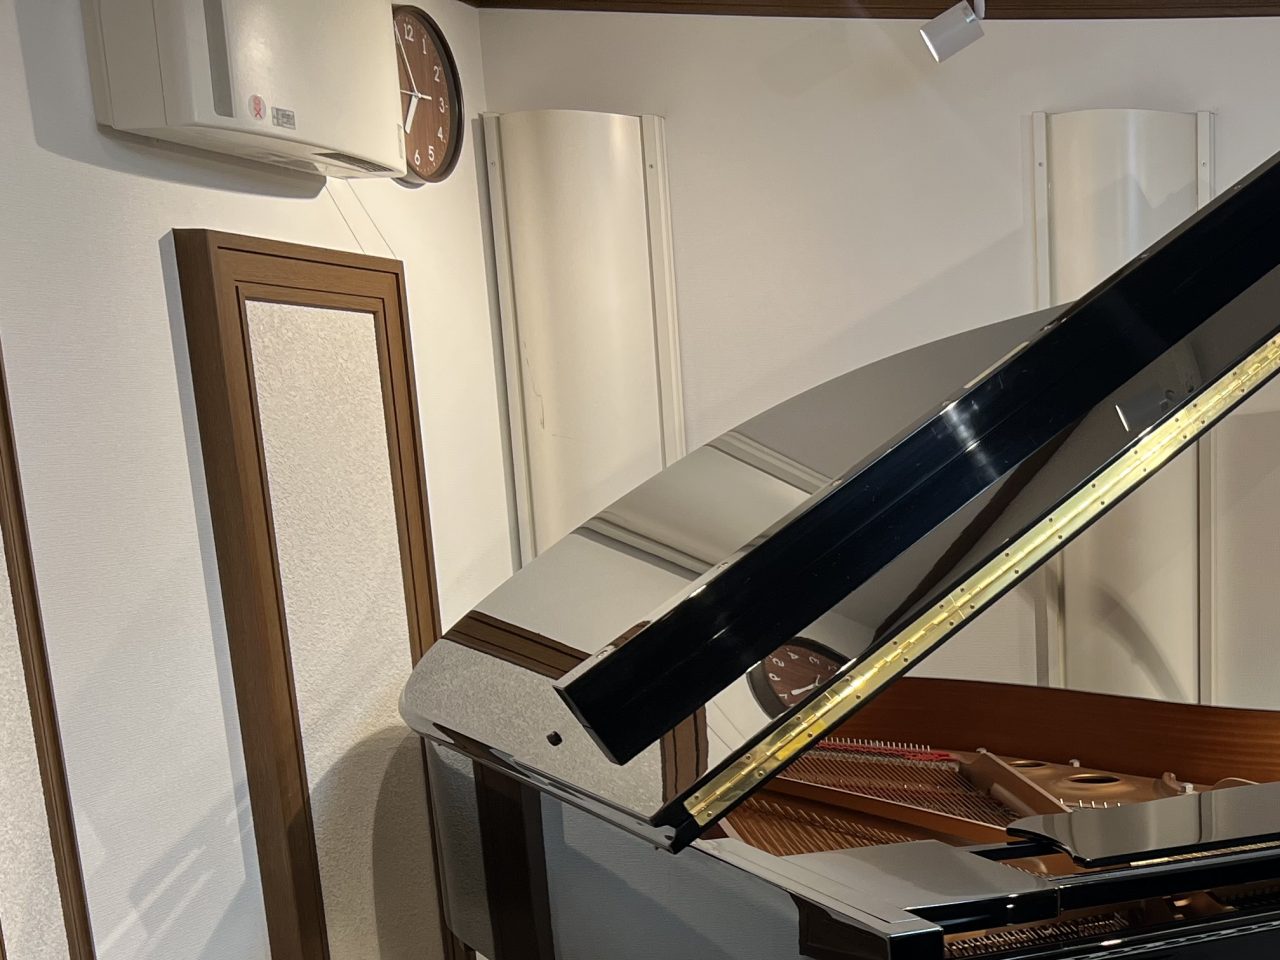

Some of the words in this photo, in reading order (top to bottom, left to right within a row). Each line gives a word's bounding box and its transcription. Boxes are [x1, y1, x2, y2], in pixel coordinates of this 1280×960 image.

[403, 23, 414, 42] 12
[421, 38, 427, 55] 1
[433, 65, 440, 83] 2
[439, 97, 445, 114] 3
[437, 126, 444, 142] 4
[414, 149, 421, 165] 6
[428, 145, 435, 162] 5
